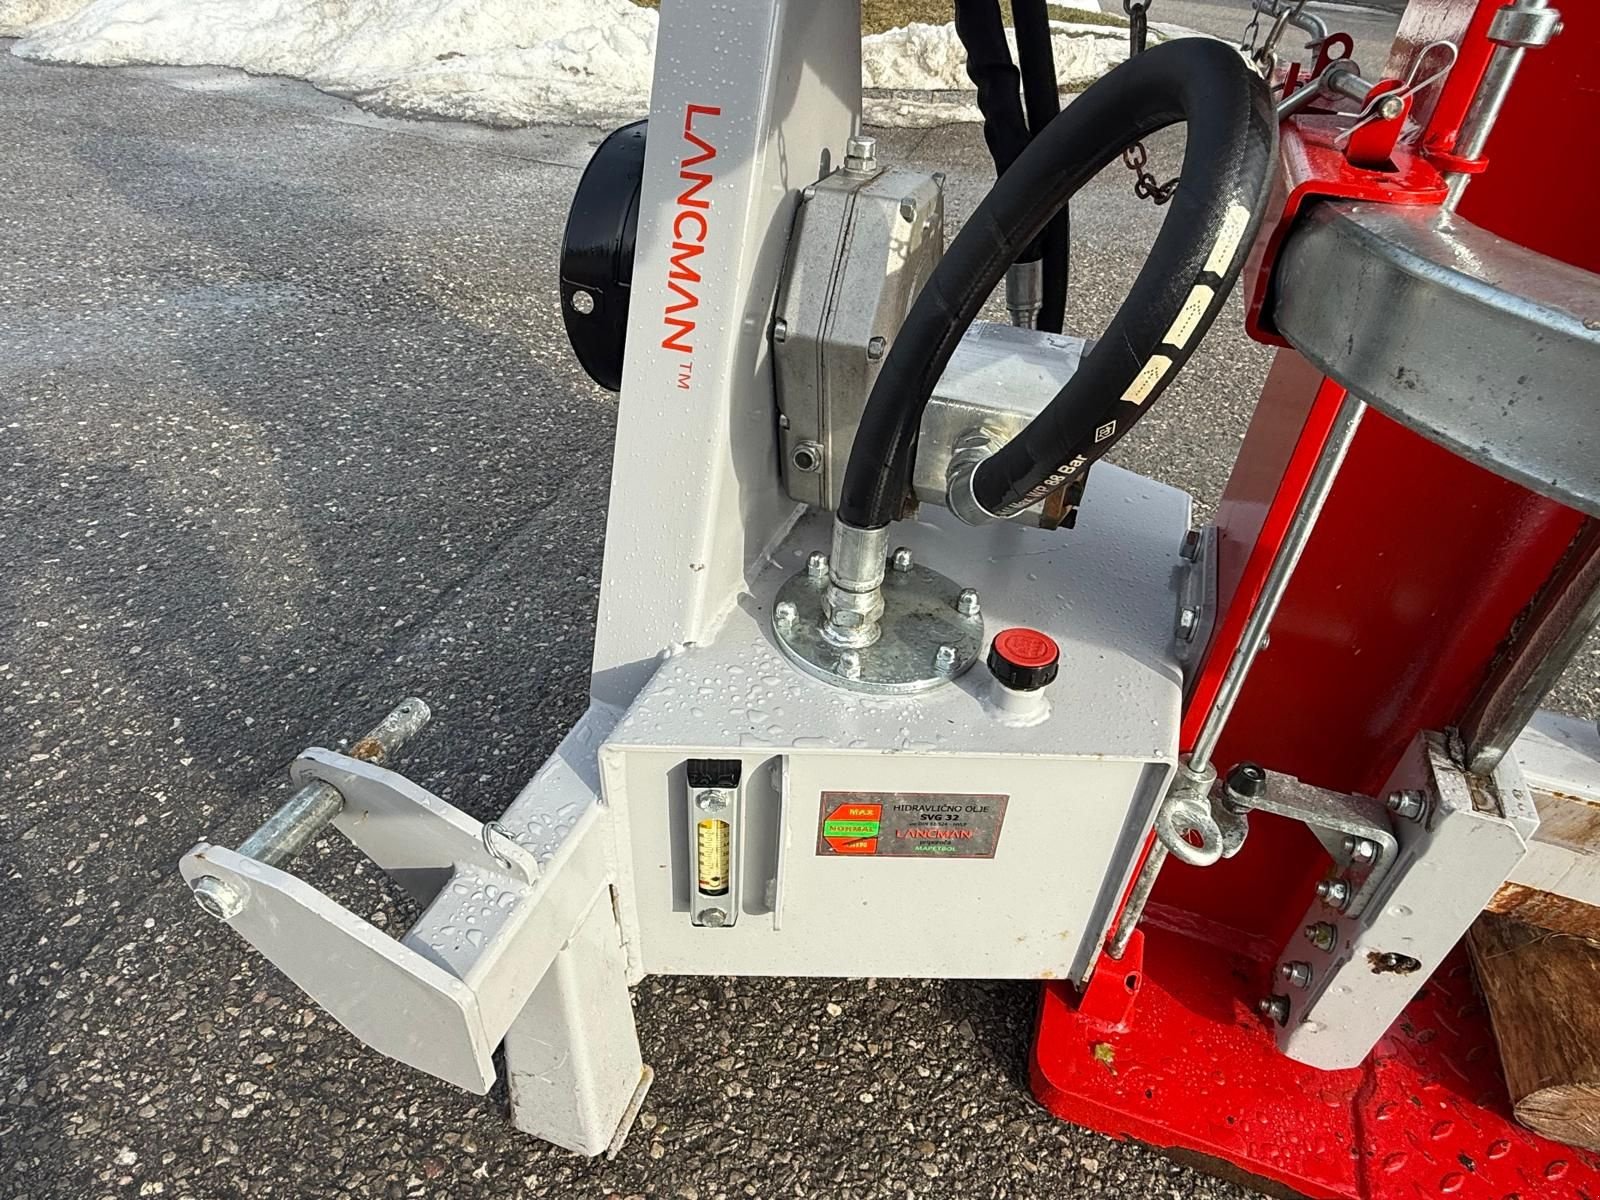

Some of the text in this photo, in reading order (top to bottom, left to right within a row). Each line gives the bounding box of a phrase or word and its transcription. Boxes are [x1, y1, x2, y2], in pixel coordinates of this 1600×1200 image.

[661, 104, 721, 354] LANCMAN
[1044, 474, 1066, 486] 88
[1057, 454, 1088, 475] Bar
[848, 808, 874, 816] MAX
[893, 804, 991, 813] HIDRAVLIČNO OLJE
[895, 829, 975, 840] LANCMAN
